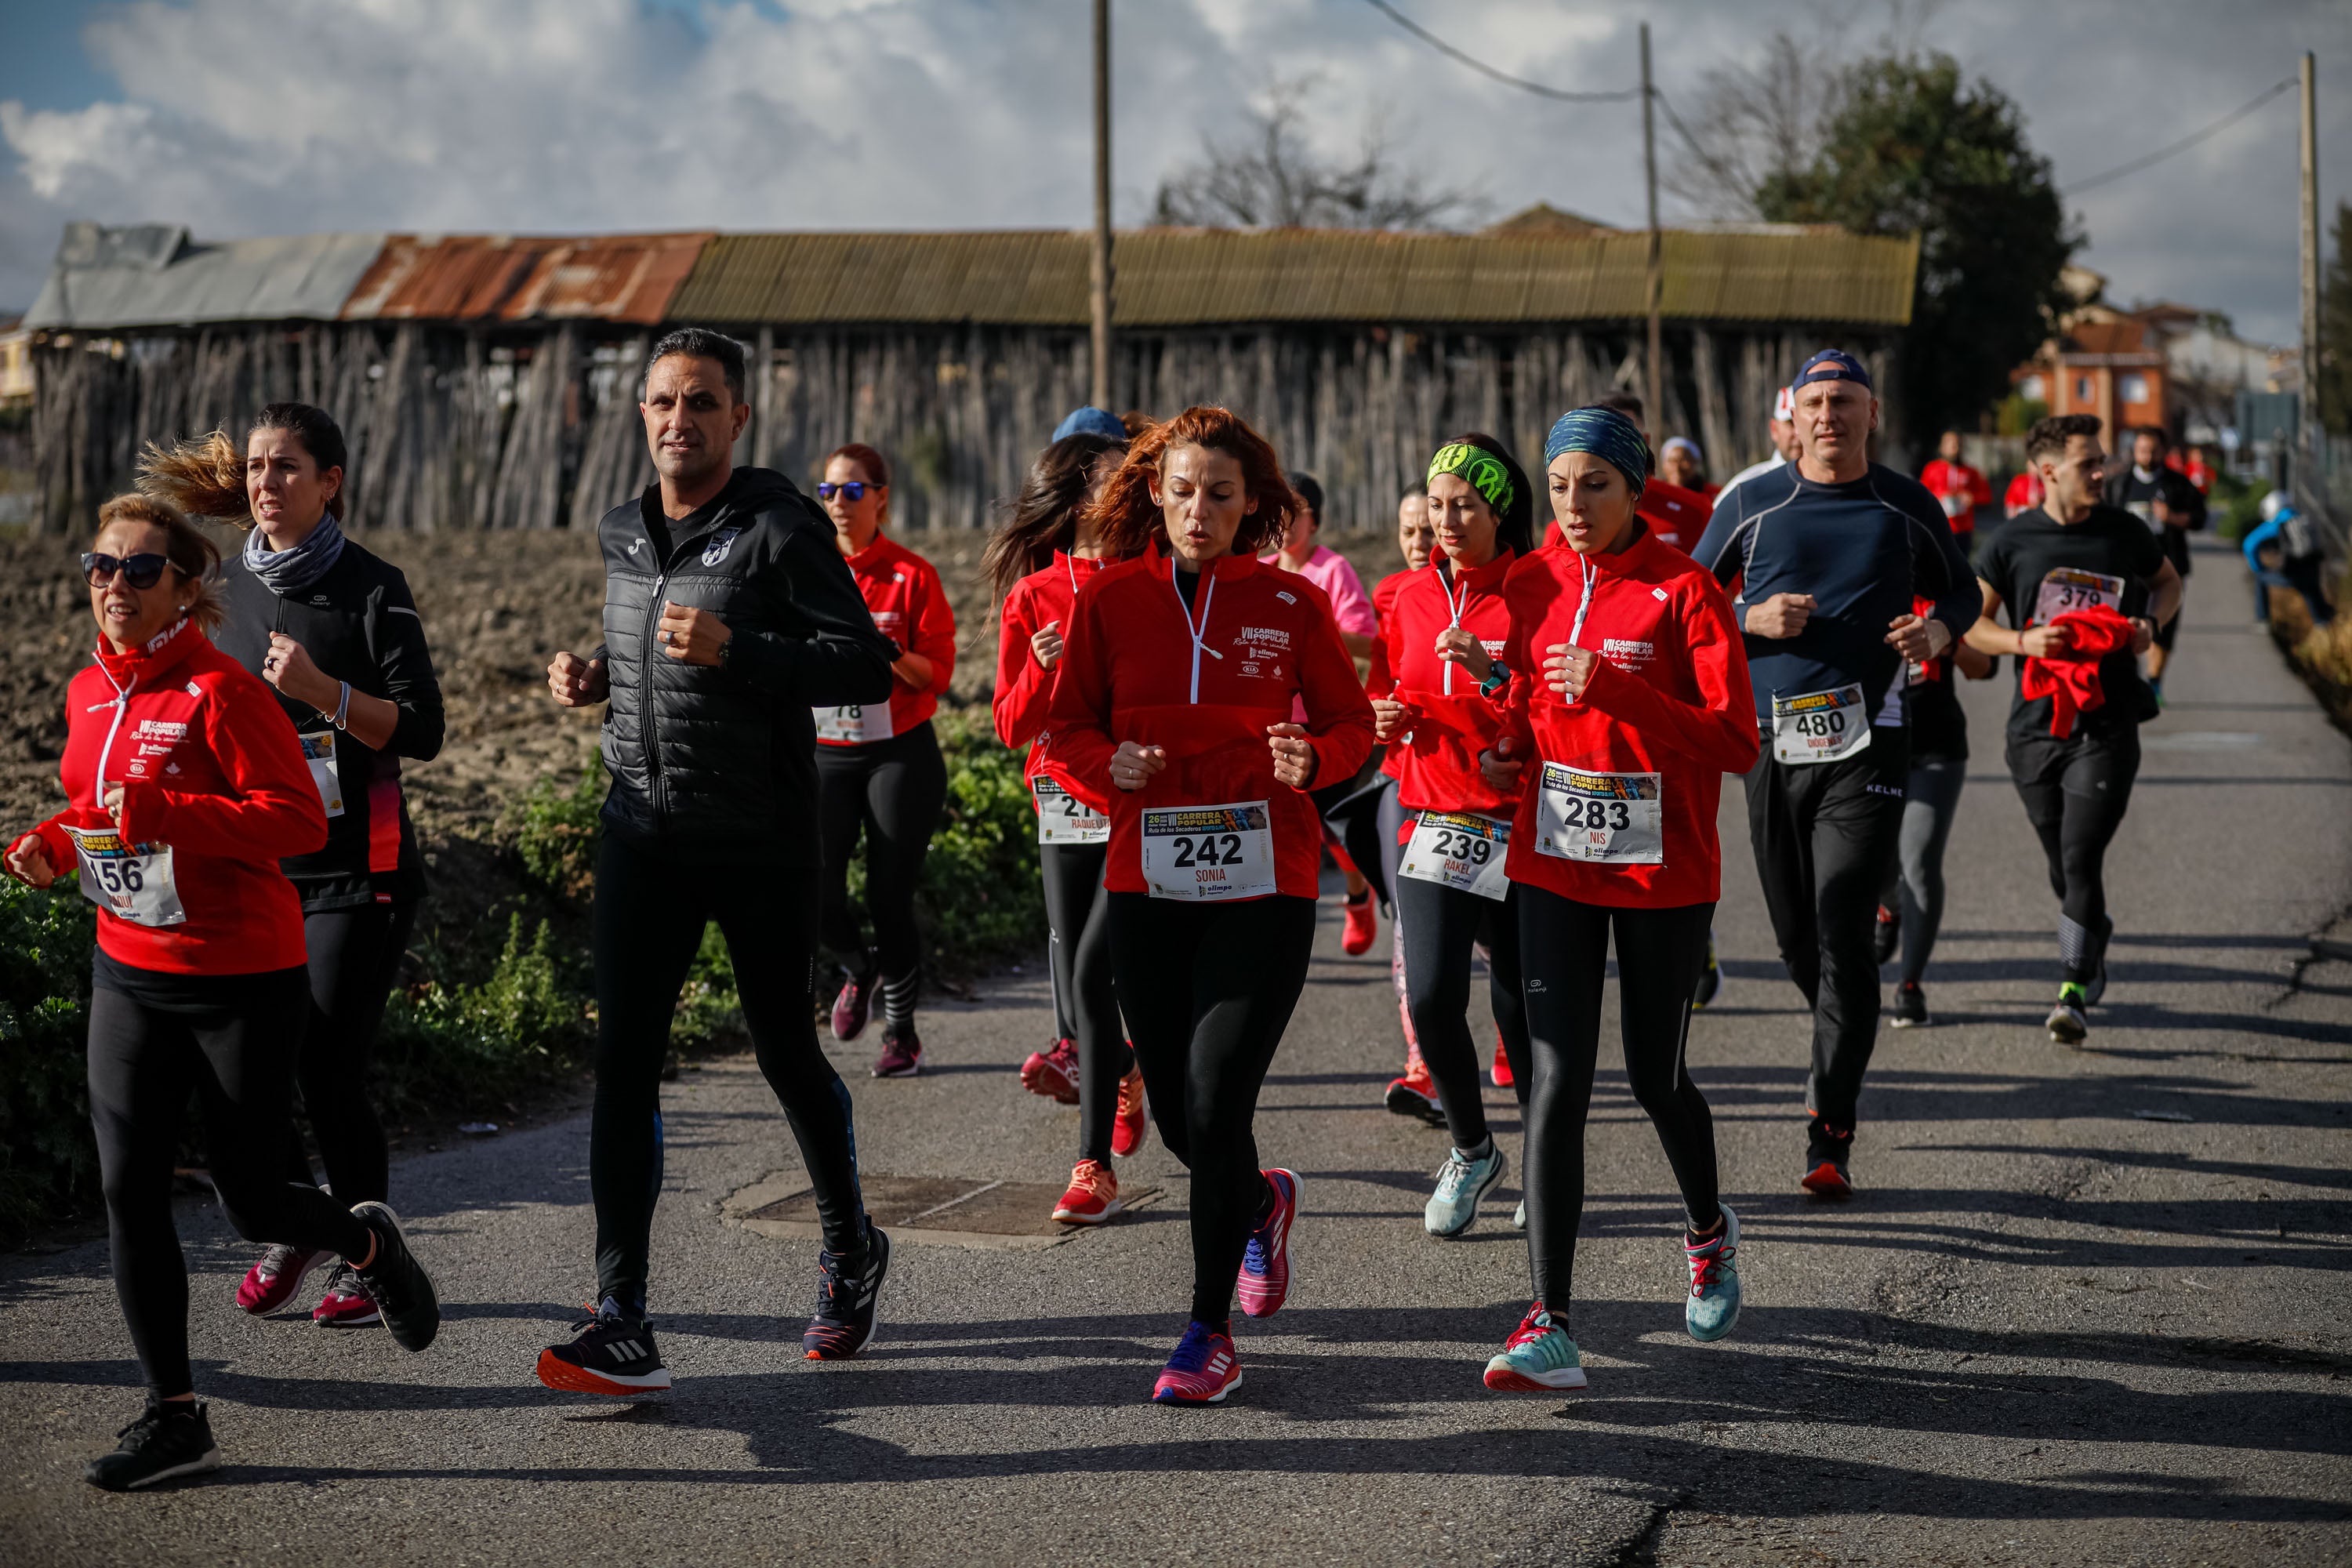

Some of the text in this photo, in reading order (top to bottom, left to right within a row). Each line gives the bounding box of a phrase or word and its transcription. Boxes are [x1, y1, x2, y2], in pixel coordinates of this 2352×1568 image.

[2060, 586, 2100, 608] 379
[1241, 626, 1290, 639] VII CARRERA
[1254, 633, 1289, 644] POPULAR
[1603, 639, 1653, 652] VII CARRERA
[1614, 646, 1653, 655] POPULAR
[1258, 649, 1278, 658] olimpo
[151, 721, 187, 730] CARRERA
[1797, 711, 1845, 736] 480
[149, 728, 186, 736] POPULAR
[1546, 768, 1556, 779] 26
[1563, 771, 1571, 785] VII
[1570, 774, 1612, 786] CARRERA
[1569, 786, 1592, 796] Secaderos
[1571, 781, 1612, 791] POPULAR
[1149, 815, 1160, 824] 26
[1177, 811, 1221, 820] CARRERA
[1564, 797, 1630, 831] 283
[1446, 817, 1482, 829] POPULAR
[1590, 832, 1606, 844] NIS
[1173, 833, 1243, 868] 242
[1432, 830, 1490, 866] 239
[1443, 858, 1471, 876] RAKEL
[90, 859, 143, 892] 156
[1196, 868, 1226, 883] SONIA
[1451, 875, 1472, 884] olimpo
